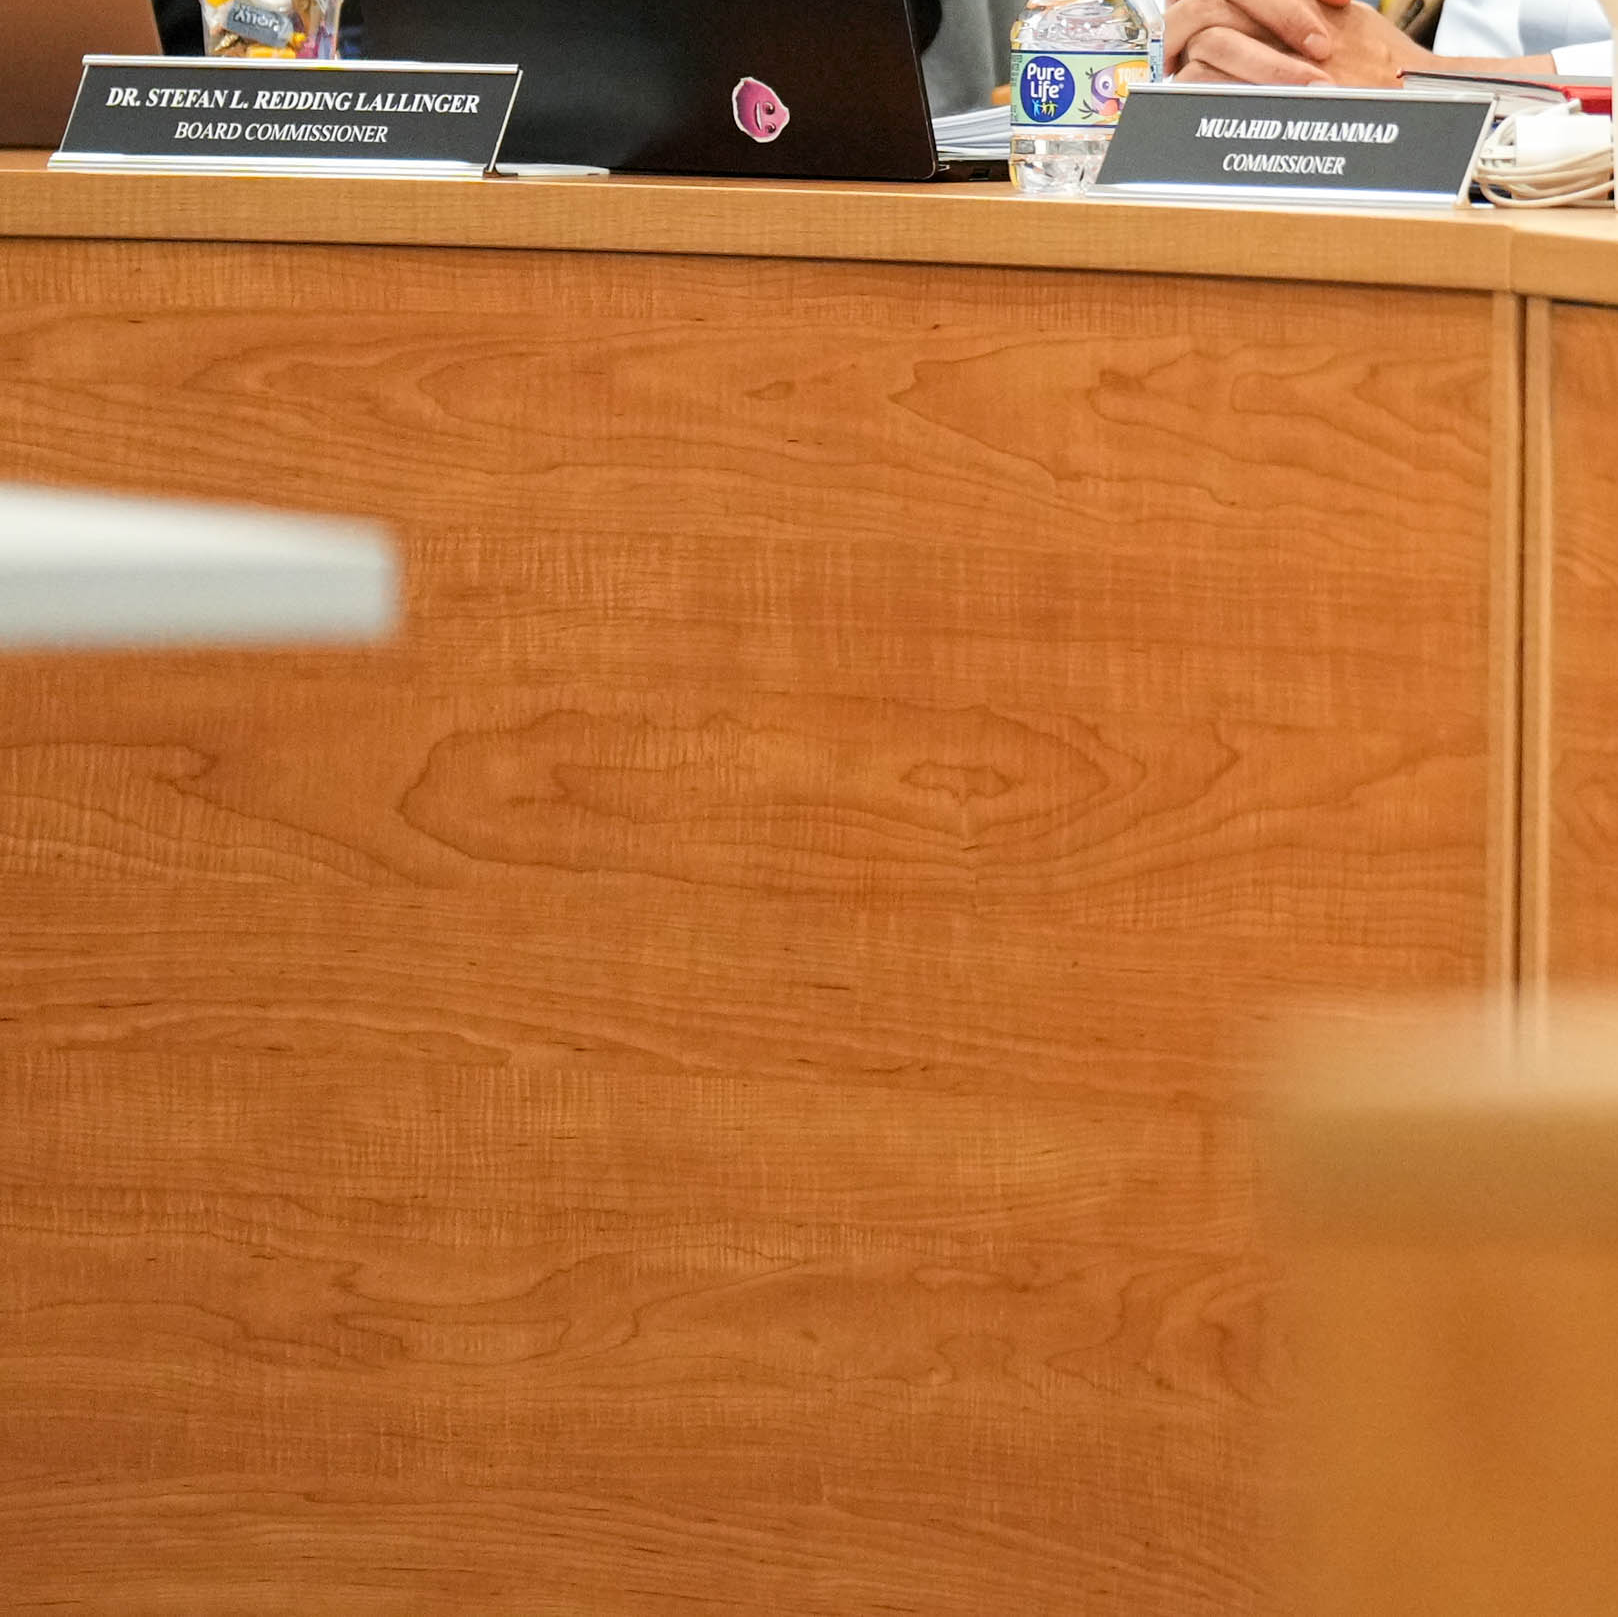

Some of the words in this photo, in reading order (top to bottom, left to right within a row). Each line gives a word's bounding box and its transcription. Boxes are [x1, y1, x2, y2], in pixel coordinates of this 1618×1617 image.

[1026, 62, 1065, 81] Pure
[105, 86, 142, 108] DR.
[145, 87, 230, 110] STEFAN
[230, 89, 249, 110] L.
[253, 90, 353, 112] REDDING
[354, 92, 480, 114] LALLINGER
[174, 121, 242, 141] BOARD
[244, 122, 389, 143] COMMISSIONER
[1195, 118, 1282, 140] MUJAHID
[1281, 120, 1399, 144] MUHAMMAD
[1222, 153, 1346, 175] COMMISSIONER
